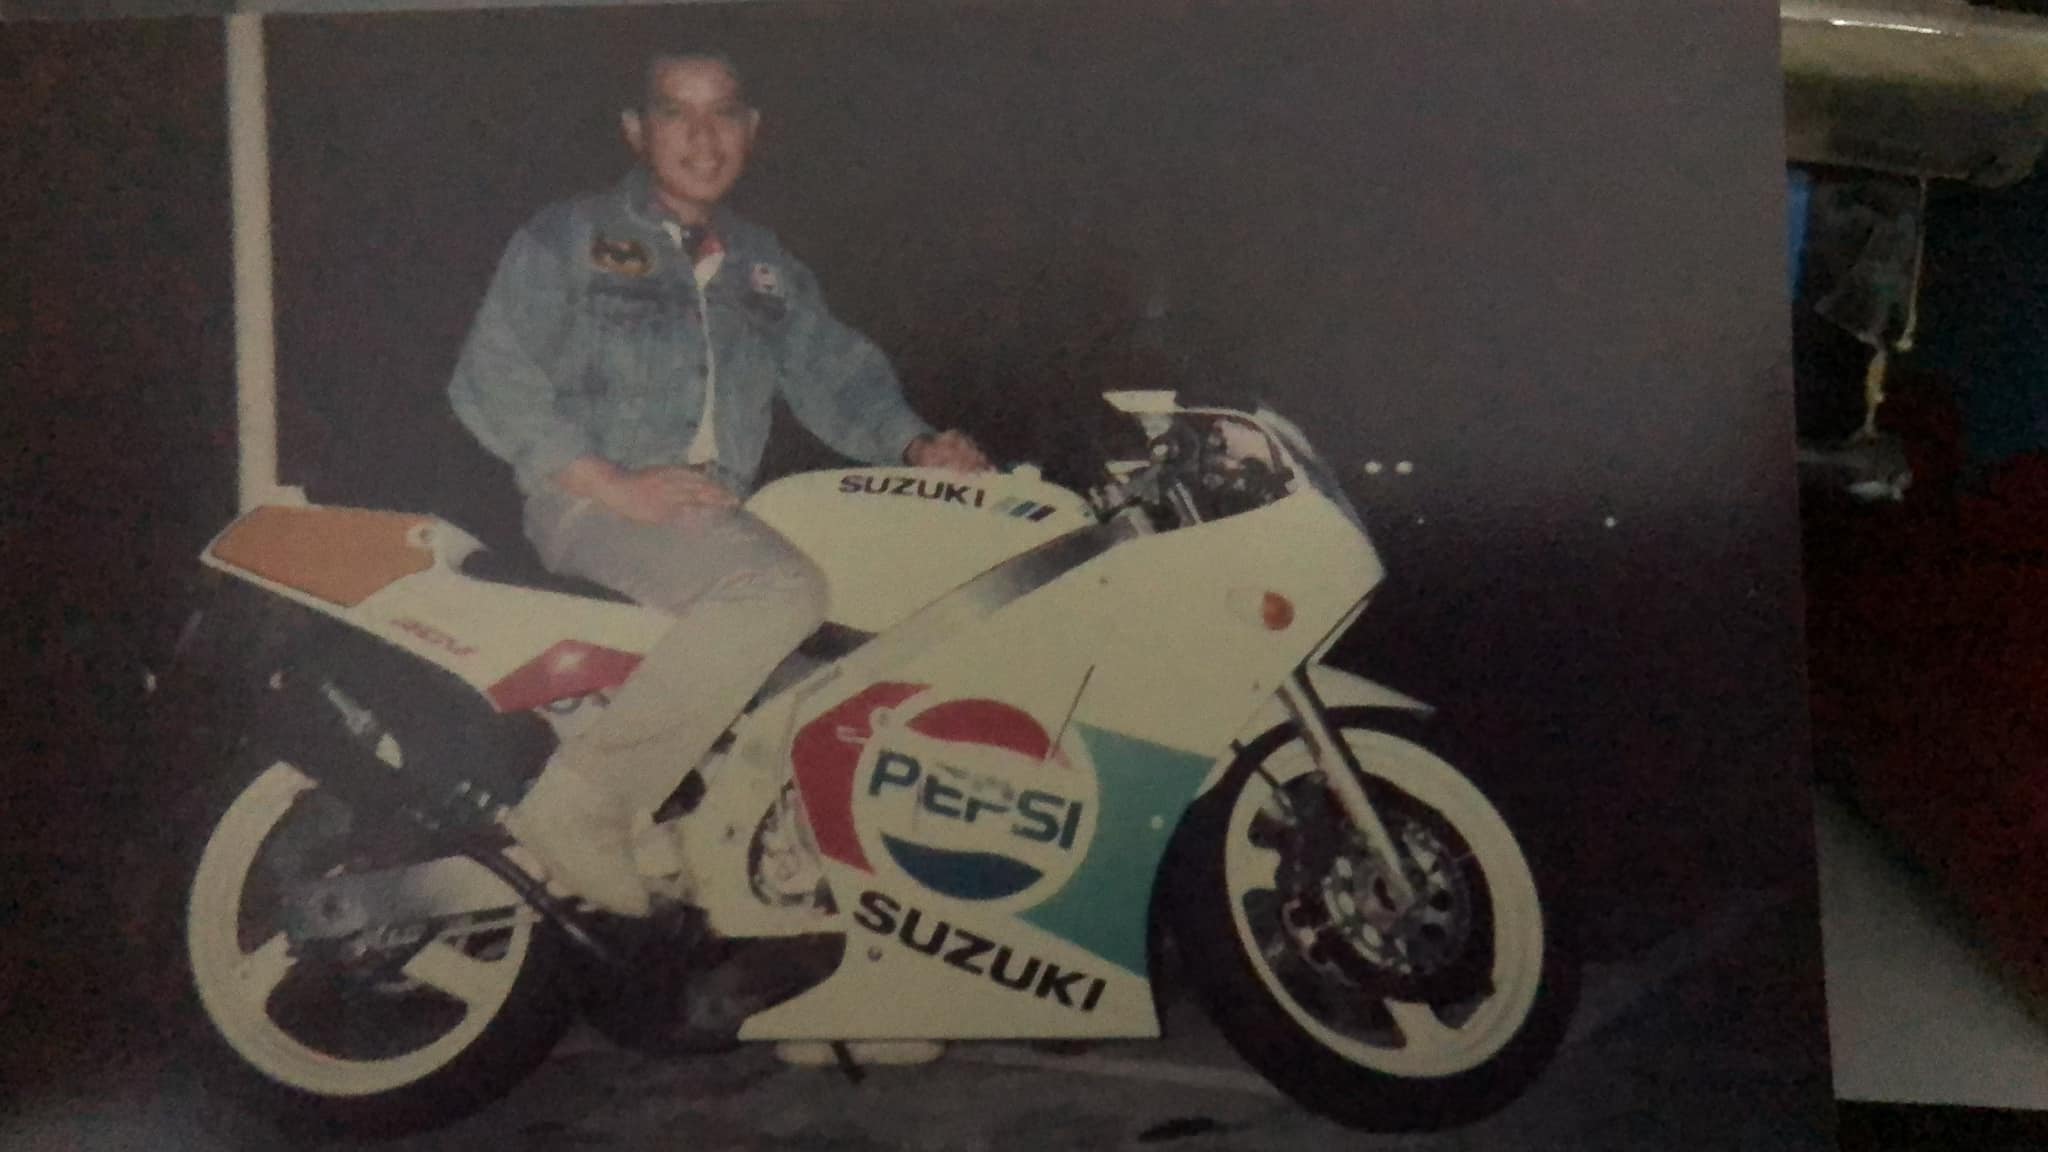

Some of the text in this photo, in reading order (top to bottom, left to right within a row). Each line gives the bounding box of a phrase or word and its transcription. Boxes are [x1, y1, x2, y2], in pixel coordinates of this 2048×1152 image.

[839, 475, 985, 508] SUZUKI
[868, 749, 1083, 852] PEPSI
[853, 890, 1107, 1013] SUZUKI
